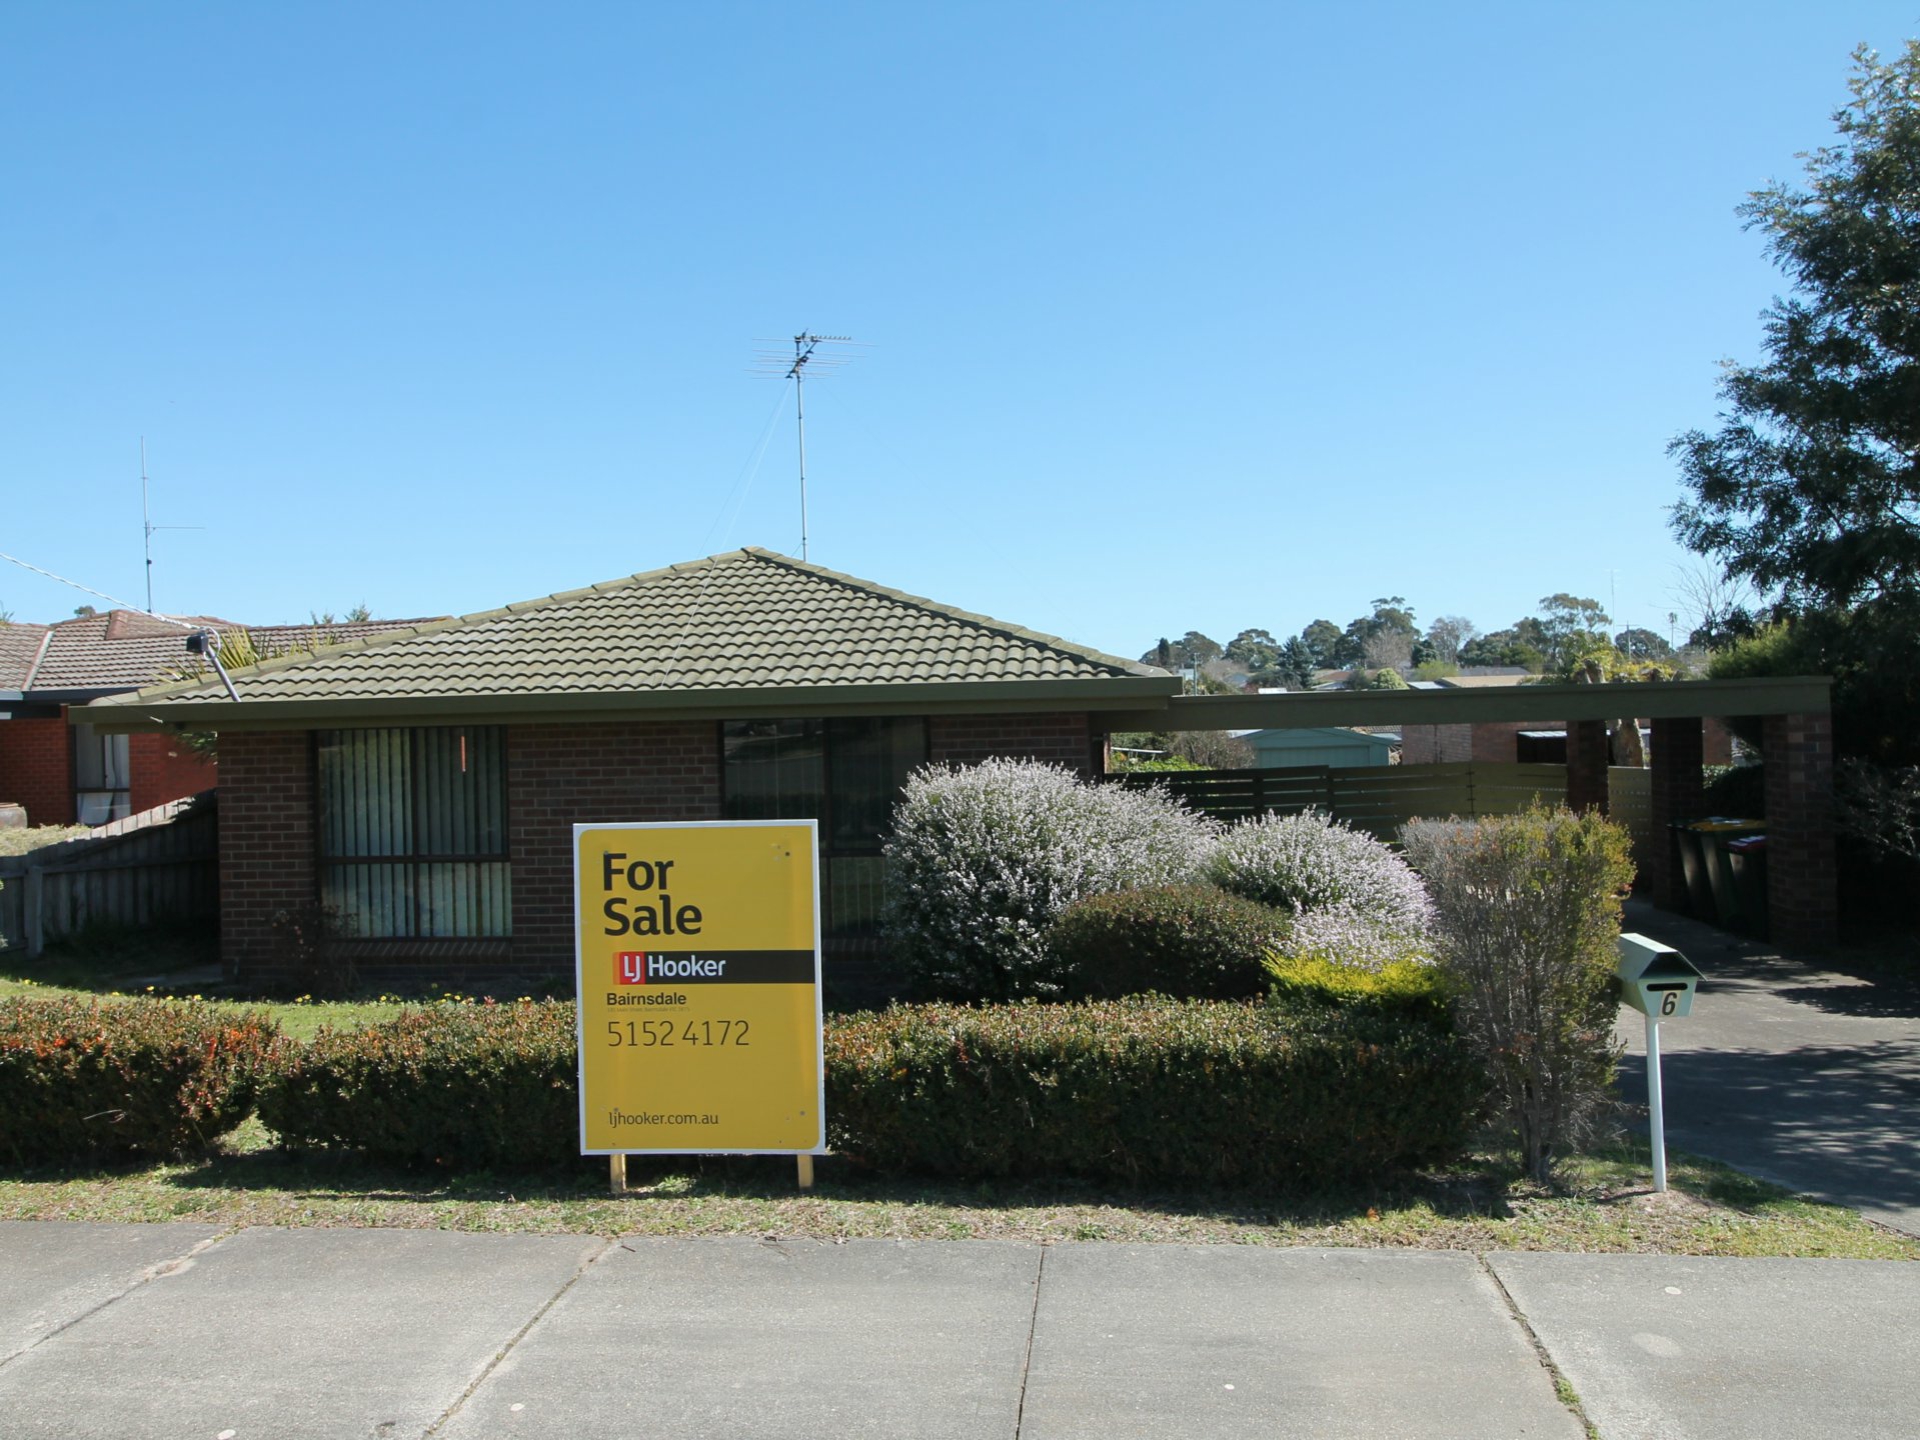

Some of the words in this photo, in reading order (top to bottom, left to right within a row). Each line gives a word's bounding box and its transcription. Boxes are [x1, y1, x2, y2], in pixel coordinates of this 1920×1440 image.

[603, 853, 674, 891] For
[604, 894, 702, 936] Sale
[624, 955, 642, 982] LJ
[648, 955, 726, 976] Hooker
[606, 992, 686, 1006] Bairnsdale
[1662, 992, 1677, 1015] 6
[608, 1021, 674, 1046] 5152
[682, 1020, 750, 1045] 4172
[609, 1112, 719, 1128] ljhooker.com.au
